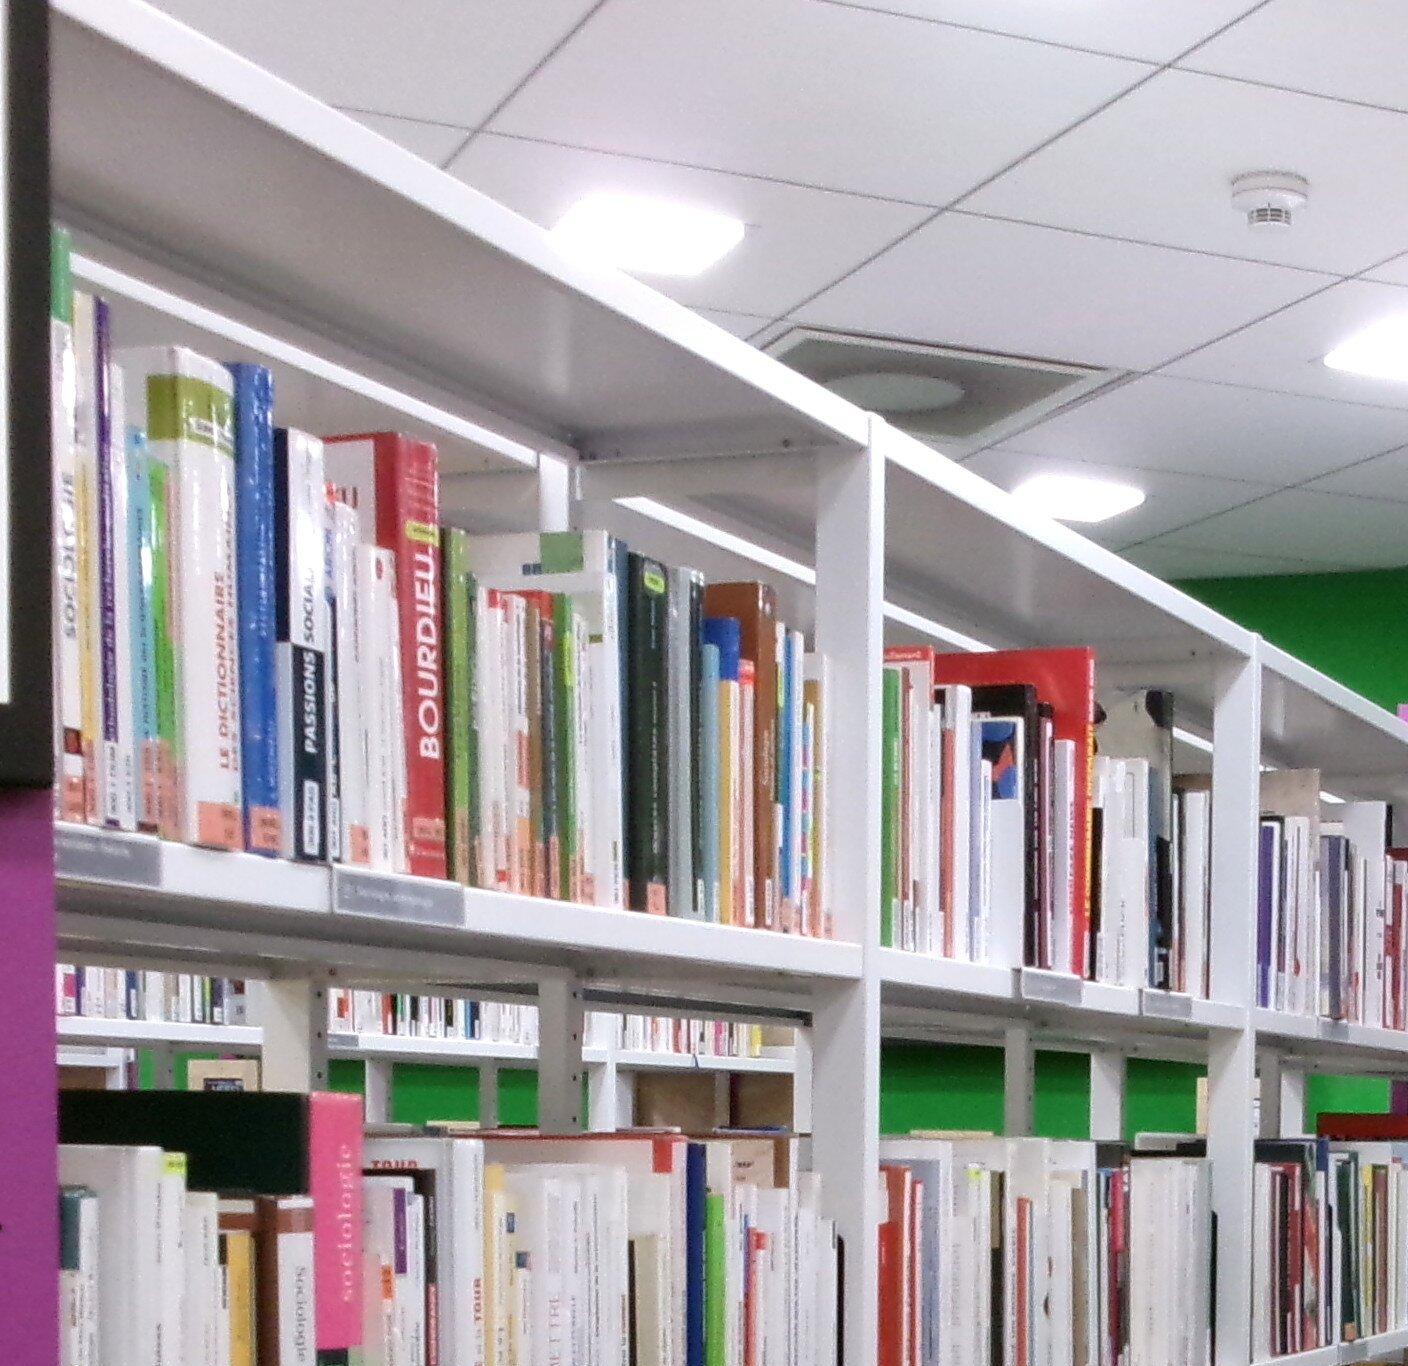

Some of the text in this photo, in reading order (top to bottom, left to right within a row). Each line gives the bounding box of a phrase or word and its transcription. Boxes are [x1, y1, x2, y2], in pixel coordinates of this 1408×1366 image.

[213, 571, 229, 769] LE DICTIONNAIRE
[303, 651, 319, 753] PASSIONS
[413, 547, 441, 759] BOURDIEU
[336, 1142, 355, 1303] sociologie
[293, 1264, 308, 1363] Sociologie
